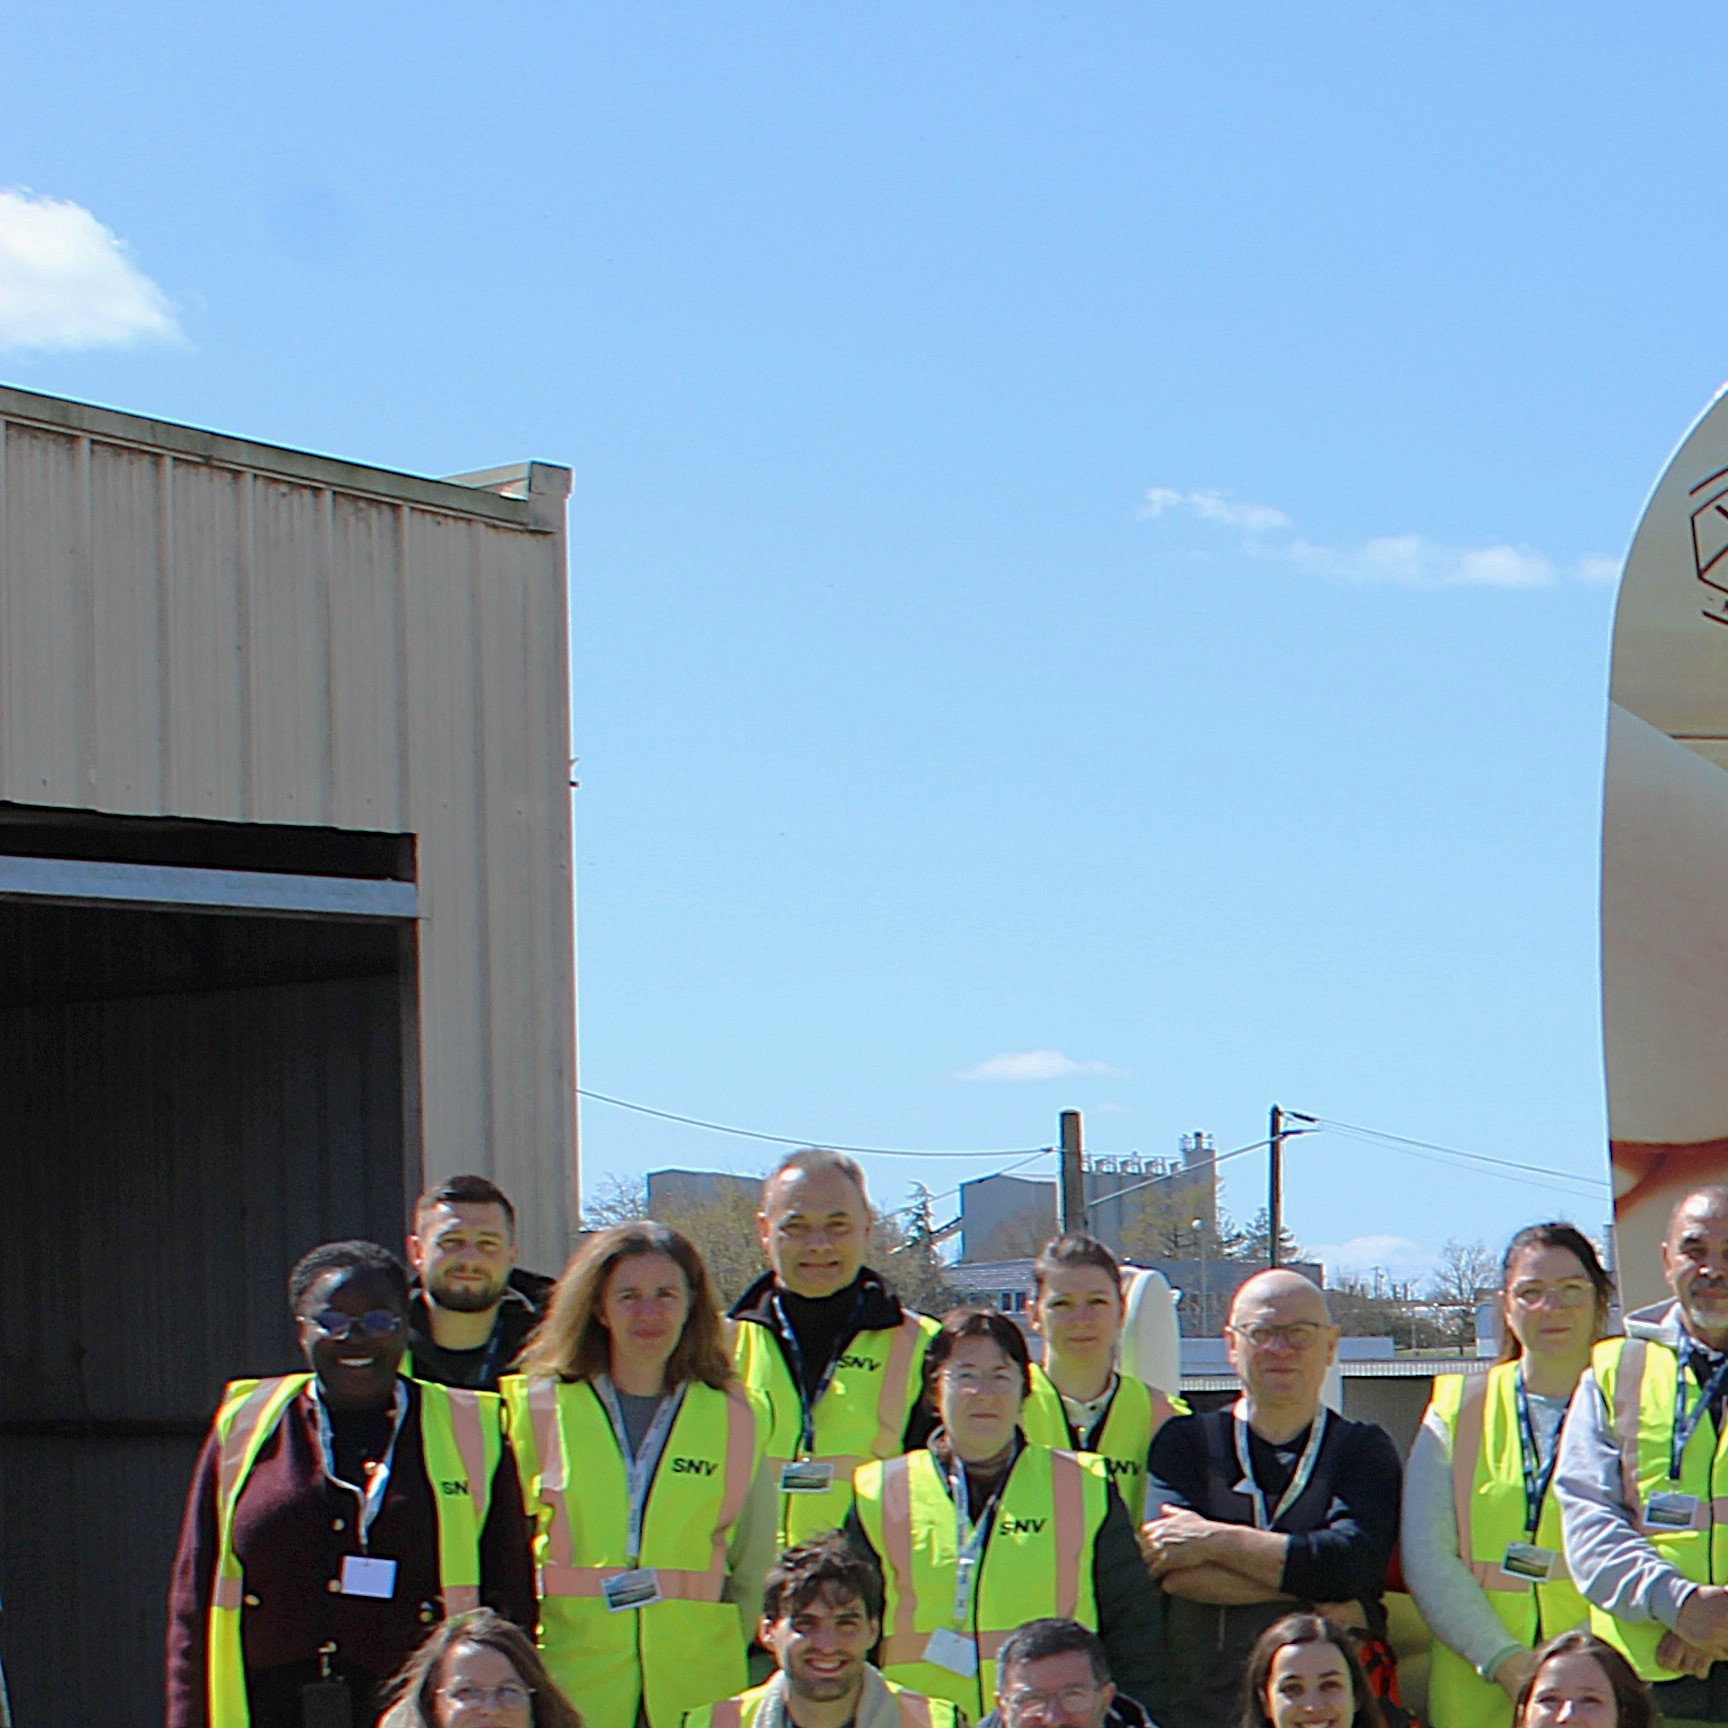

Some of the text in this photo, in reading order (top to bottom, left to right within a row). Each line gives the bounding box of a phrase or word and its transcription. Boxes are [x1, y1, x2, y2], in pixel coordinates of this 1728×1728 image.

[836, 1354, 882, 1372] SNV
[671, 1457, 719, 1477] SNV
[441, 1480, 470, 1496] SN
[999, 1517, 1048, 1537] SNV
